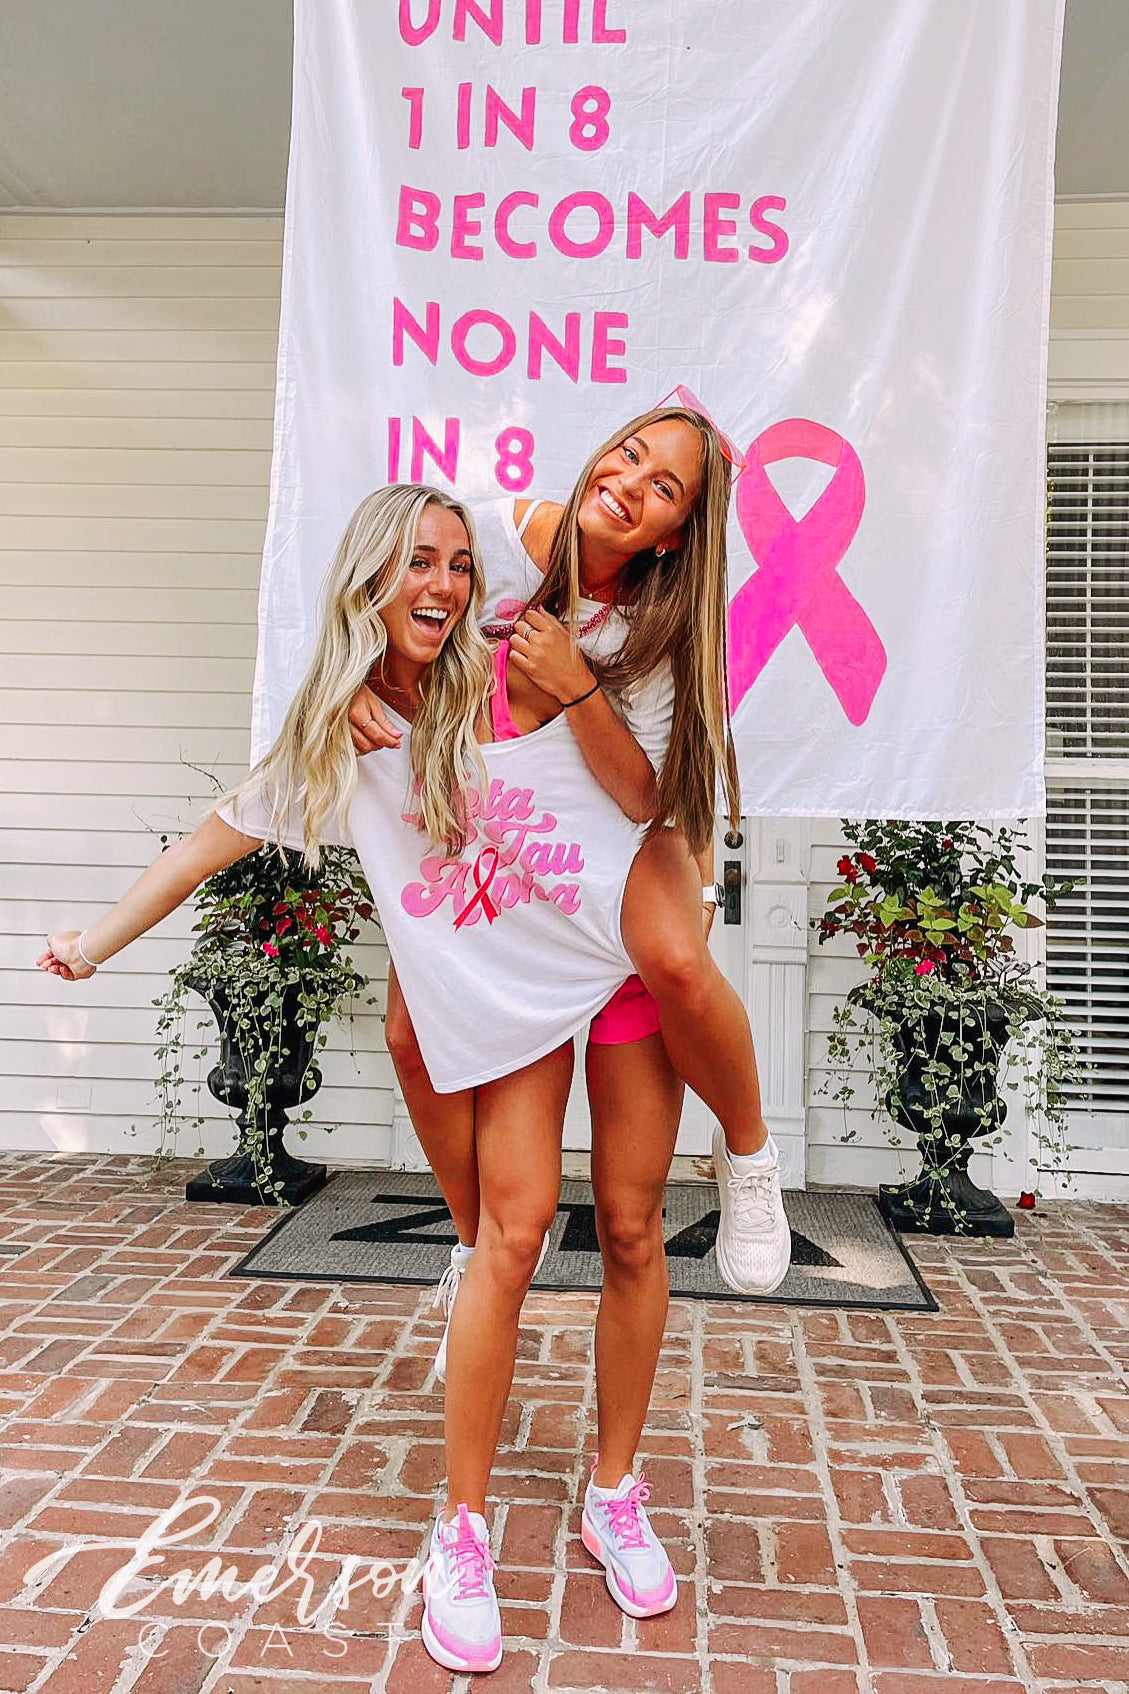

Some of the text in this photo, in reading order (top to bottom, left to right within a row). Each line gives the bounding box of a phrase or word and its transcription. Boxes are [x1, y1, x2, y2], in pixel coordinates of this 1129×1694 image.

[402, 82, 612, 151] 1 IN 8
[395, 184, 790, 264] BECOMES
[392, 296, 629, 384] NONE
[387, 415, 535, 492] IN 8
[483, 812, 585, 877] Tau
